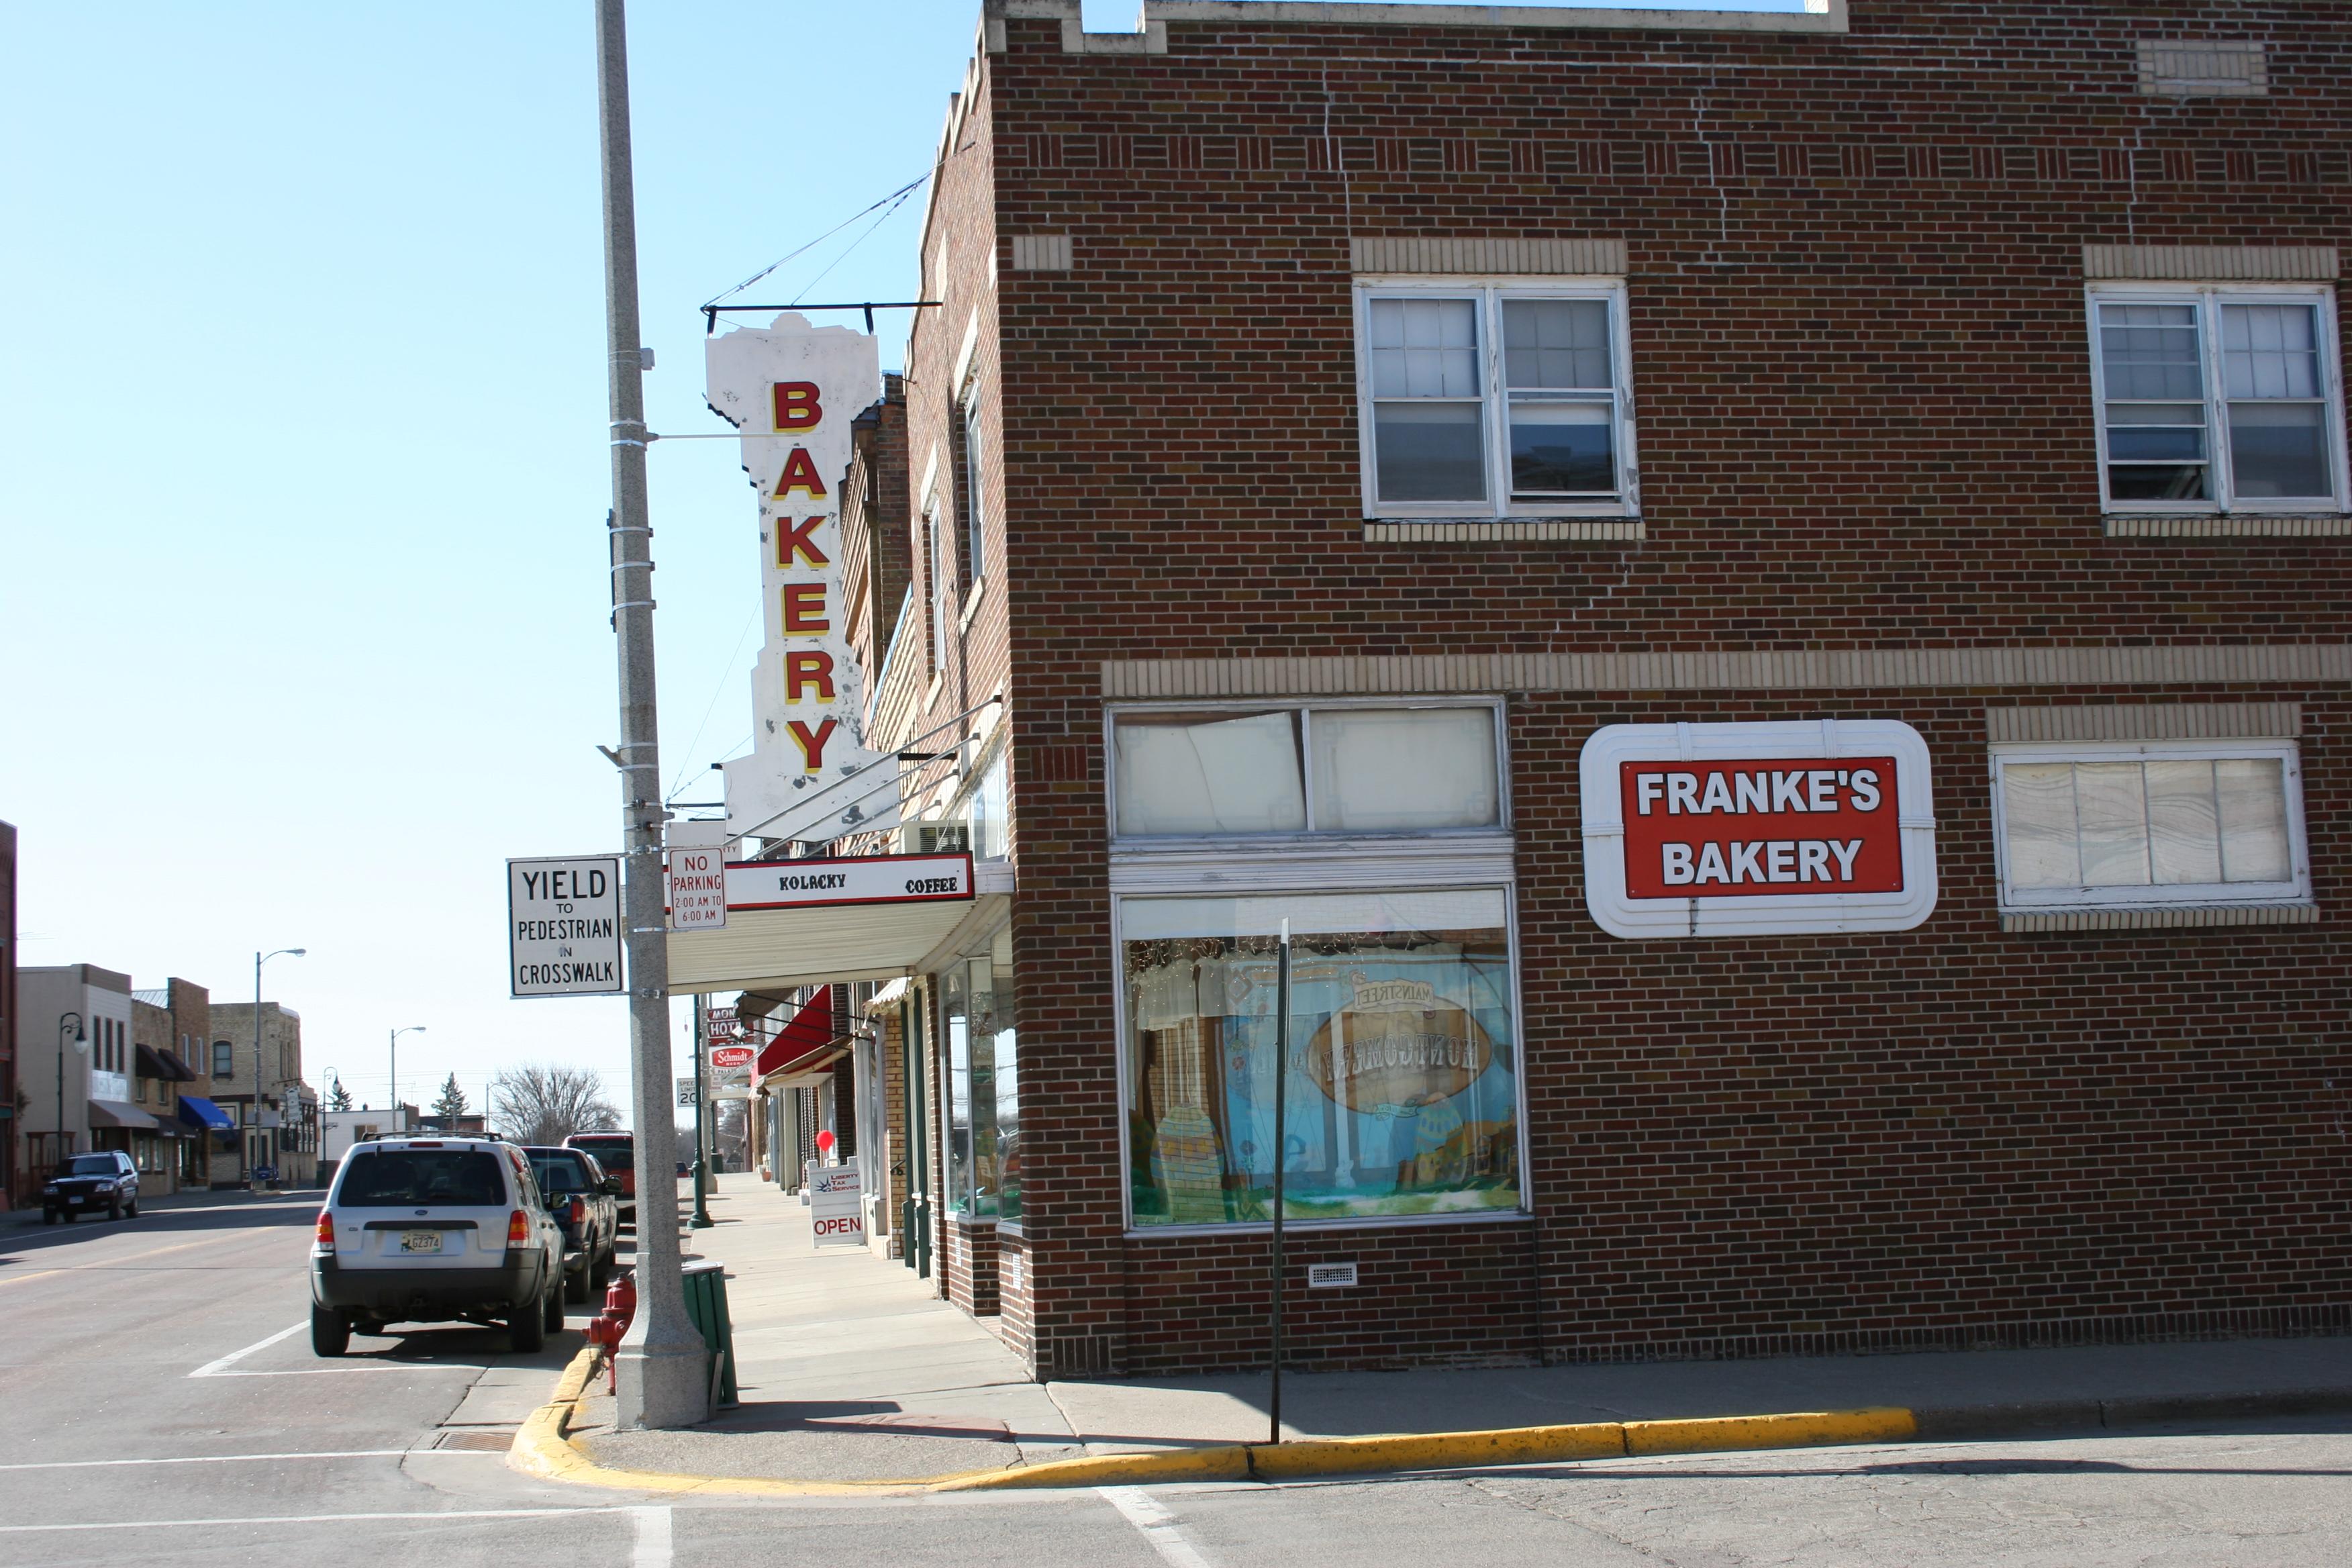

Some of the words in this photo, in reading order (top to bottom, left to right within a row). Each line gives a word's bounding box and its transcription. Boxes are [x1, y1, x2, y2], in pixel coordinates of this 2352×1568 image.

[771, 381, 838, 775] BAKERY
[1636, 768, 1881, 816] FRANKE'S
[685, 856, 707, 871] NO
[1661, 838, 1865, 886] BAKERY
[522, 869, 606, 900] YIELD
[673, 875, 722, 891] PARKING
[779, 873, 846, 891] KOLACKY
[905, 877, 958, 894] COFFEE
[556, 903, 573, 914] TO
[675, 897, 694, 908] 2:00
[697, 896, 709, 907] AM
[712, 895, 722, 906] TO
[683, 911, 701, 922] 6:00
[705, 910, 716, 920] AM
[518, 918, 612, 940] PEDESTRIAN
[560, 946, 573, 957] IN
[520, 961, 614, 985] CROSSWALK
[712, 1009, 737, 1019] MON
[718, 1050, 747, 1064] Schmidt
[814, 1217, 862, 1236] OPEN
